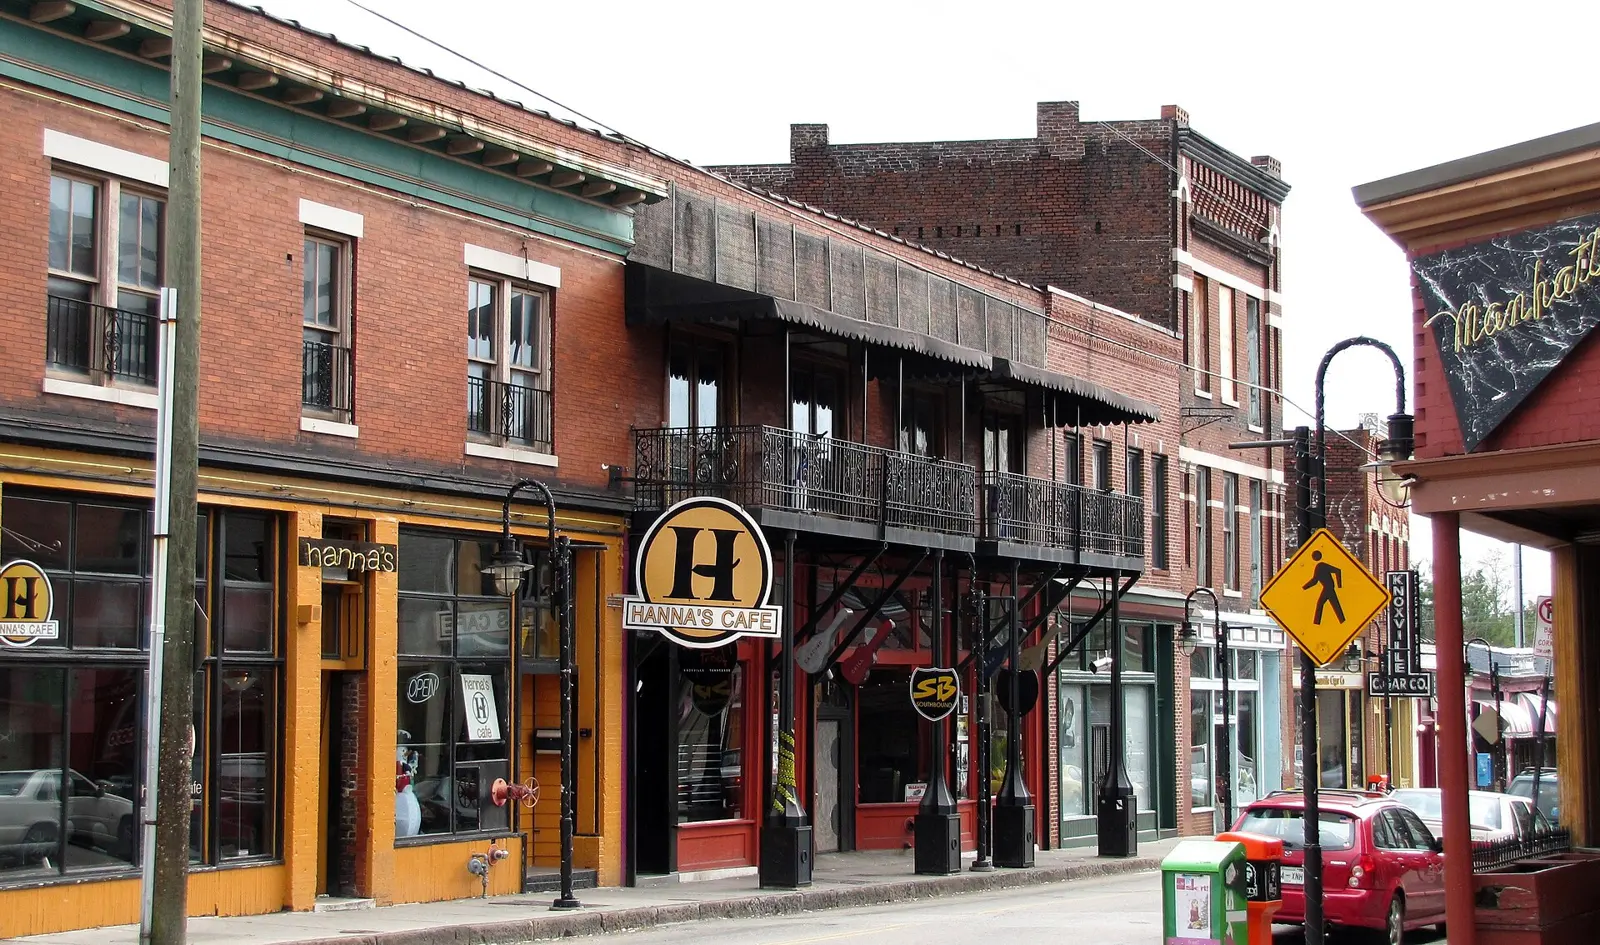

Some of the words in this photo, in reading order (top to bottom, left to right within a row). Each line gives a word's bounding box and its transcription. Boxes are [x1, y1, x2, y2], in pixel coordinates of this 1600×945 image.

[306, 542, 394, 573] hanna's
[663, 525, 745, 602] H
[2, 576, 40, 619] H
[631, 605, 714, 628] HANNA'S
[720, 609, 773, 631] CAFE
[1392, 574, 1406, 674] KNOXVILLE
[28, 624, 54, 635] CAFE
[408, 677, 438, 699] OPEN
[463, 677, 491, 692] hanna's
[913, 675, 957, 702] SB
[1409, 677, 1428, 690] CO.
[474, 697, 488, 719] H
[916, 701, 953, 709] SOUTHBOUND
[476, 726, 493, 740] cafe
